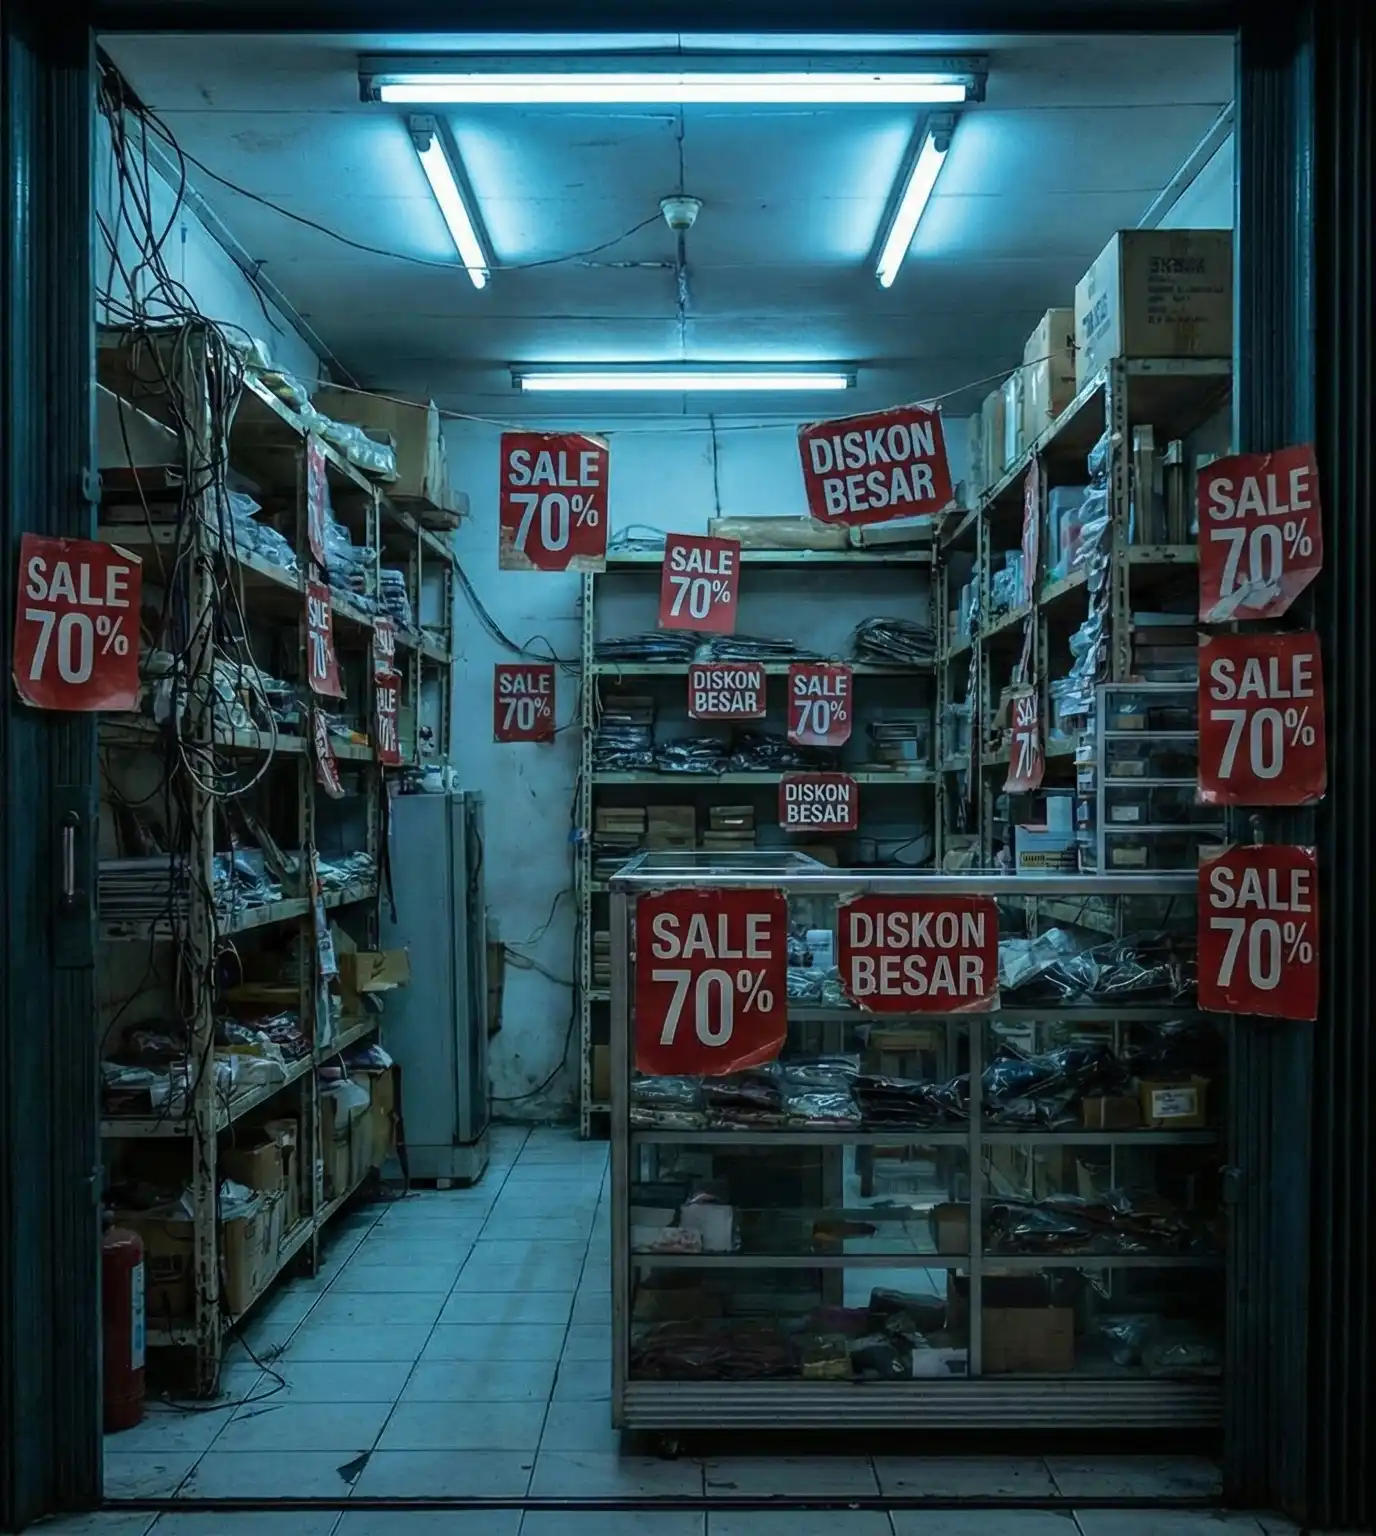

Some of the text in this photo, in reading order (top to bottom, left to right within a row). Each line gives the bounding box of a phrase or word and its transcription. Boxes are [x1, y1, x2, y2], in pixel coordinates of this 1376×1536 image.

[508, 449, 600, 487] SALE
[809, 419, 936, 475] DISKON
[821, 464, 936, 516] BESAR
[1208, 466, 1312, 521] SALE
[509, 492, 600, 552] 70%
[670, 546, 734, 575] SALE
[1210, 517, 1313, 598] 70%
[25, 556, 130, 608] SALE
[669, 576, 731, 619] 70%
[25, 608, 129, 684] 70%
[499, 672, 550, 694] SALE
[693, 670, 761, 690] DISKON
[793, 675, 848, 697] SALE
[1210, 654, 1314, 701] SALE
[499, 697, 551, 731] 70%
[695, 691, 757, 713] BESAR
[794, 699, 847, 736] 70%
[1210, 706, 1315, 779] 70%
[785, 783, 850, 802] DISKON
[787, 804, 849, 823] BESAR
[1209, 867, 1312, 913] SALE
[651, 913, 772, 959] SALE
[849, 911, 985, 949] DISKON
[851, 954, 985, 996] BESAR
[1210, 918, 1313, 990] 70%
[651, 969, 774, 1047] 70%
